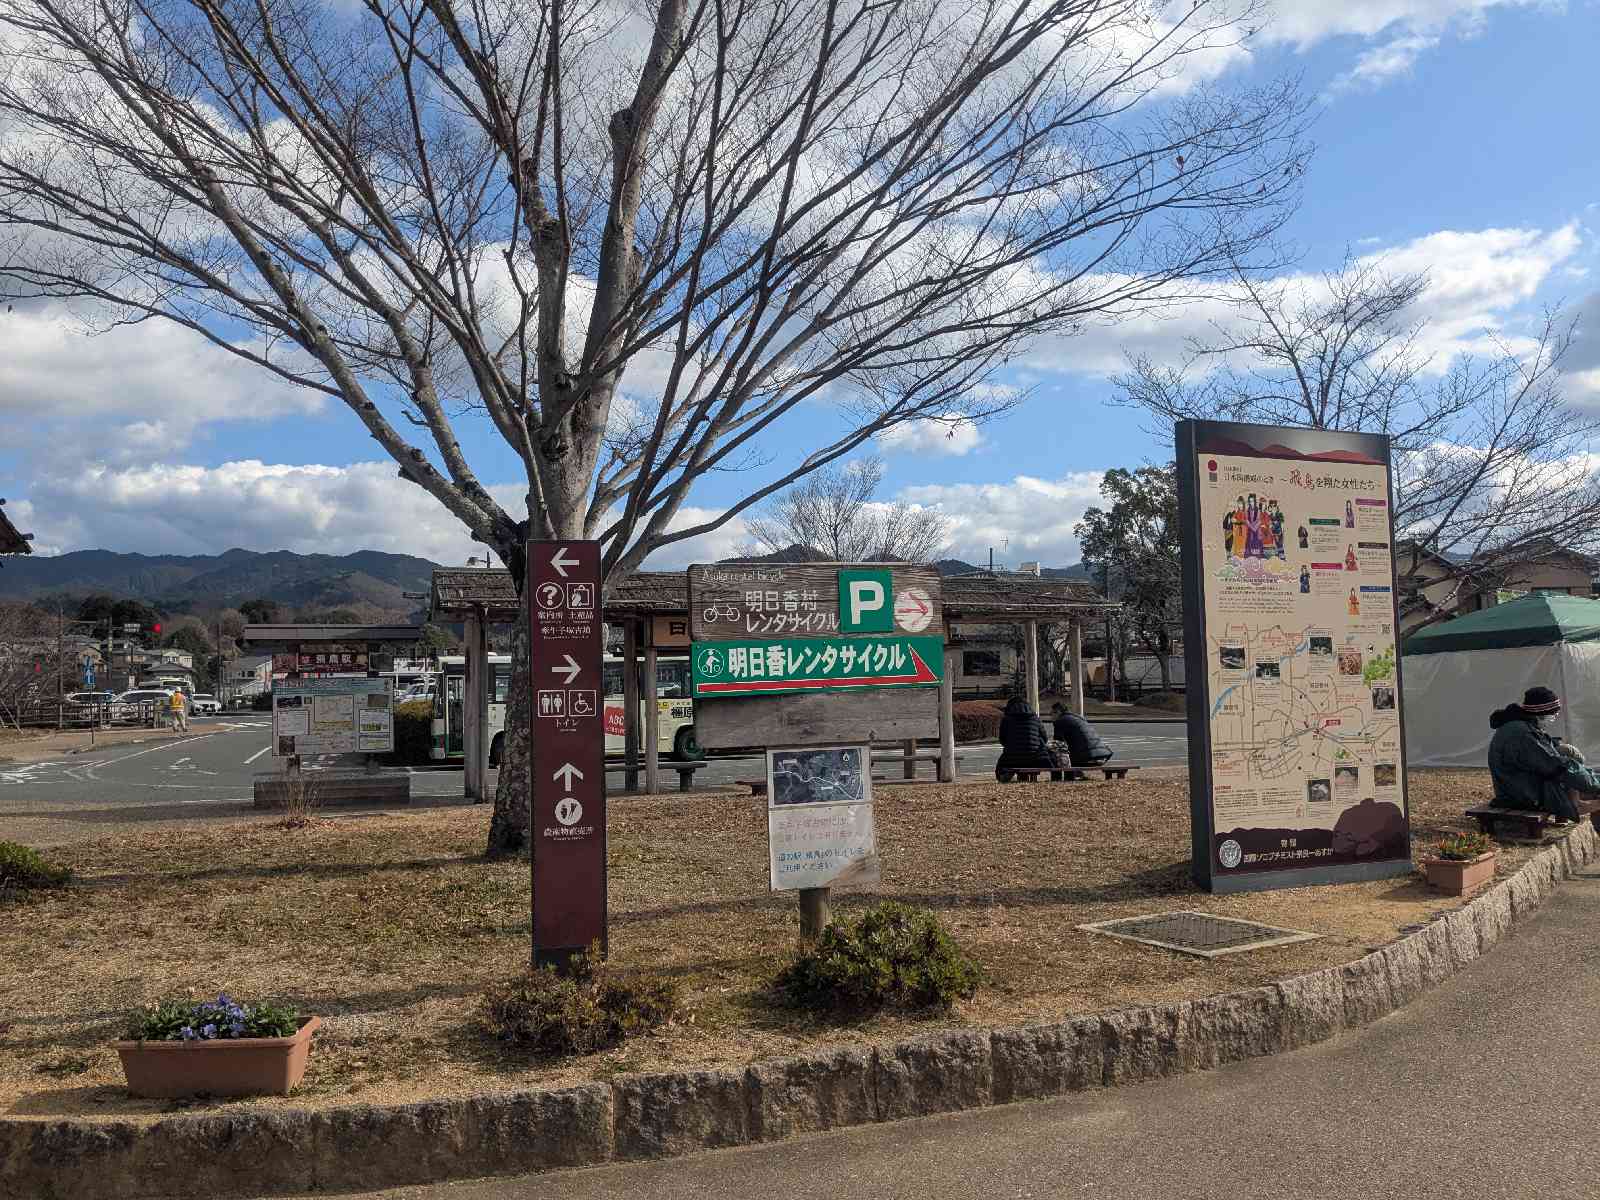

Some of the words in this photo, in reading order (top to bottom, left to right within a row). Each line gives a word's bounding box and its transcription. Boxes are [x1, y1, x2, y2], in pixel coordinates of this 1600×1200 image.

[745, 590, 818, 612] 明日香村
[849, 580, 885, 625] P
[746, 613, 841, 633] レンタサイクル
[728, 643, 906, 678] 明日香レンタサイクル
[556, 719, 580, 729] トイレ
